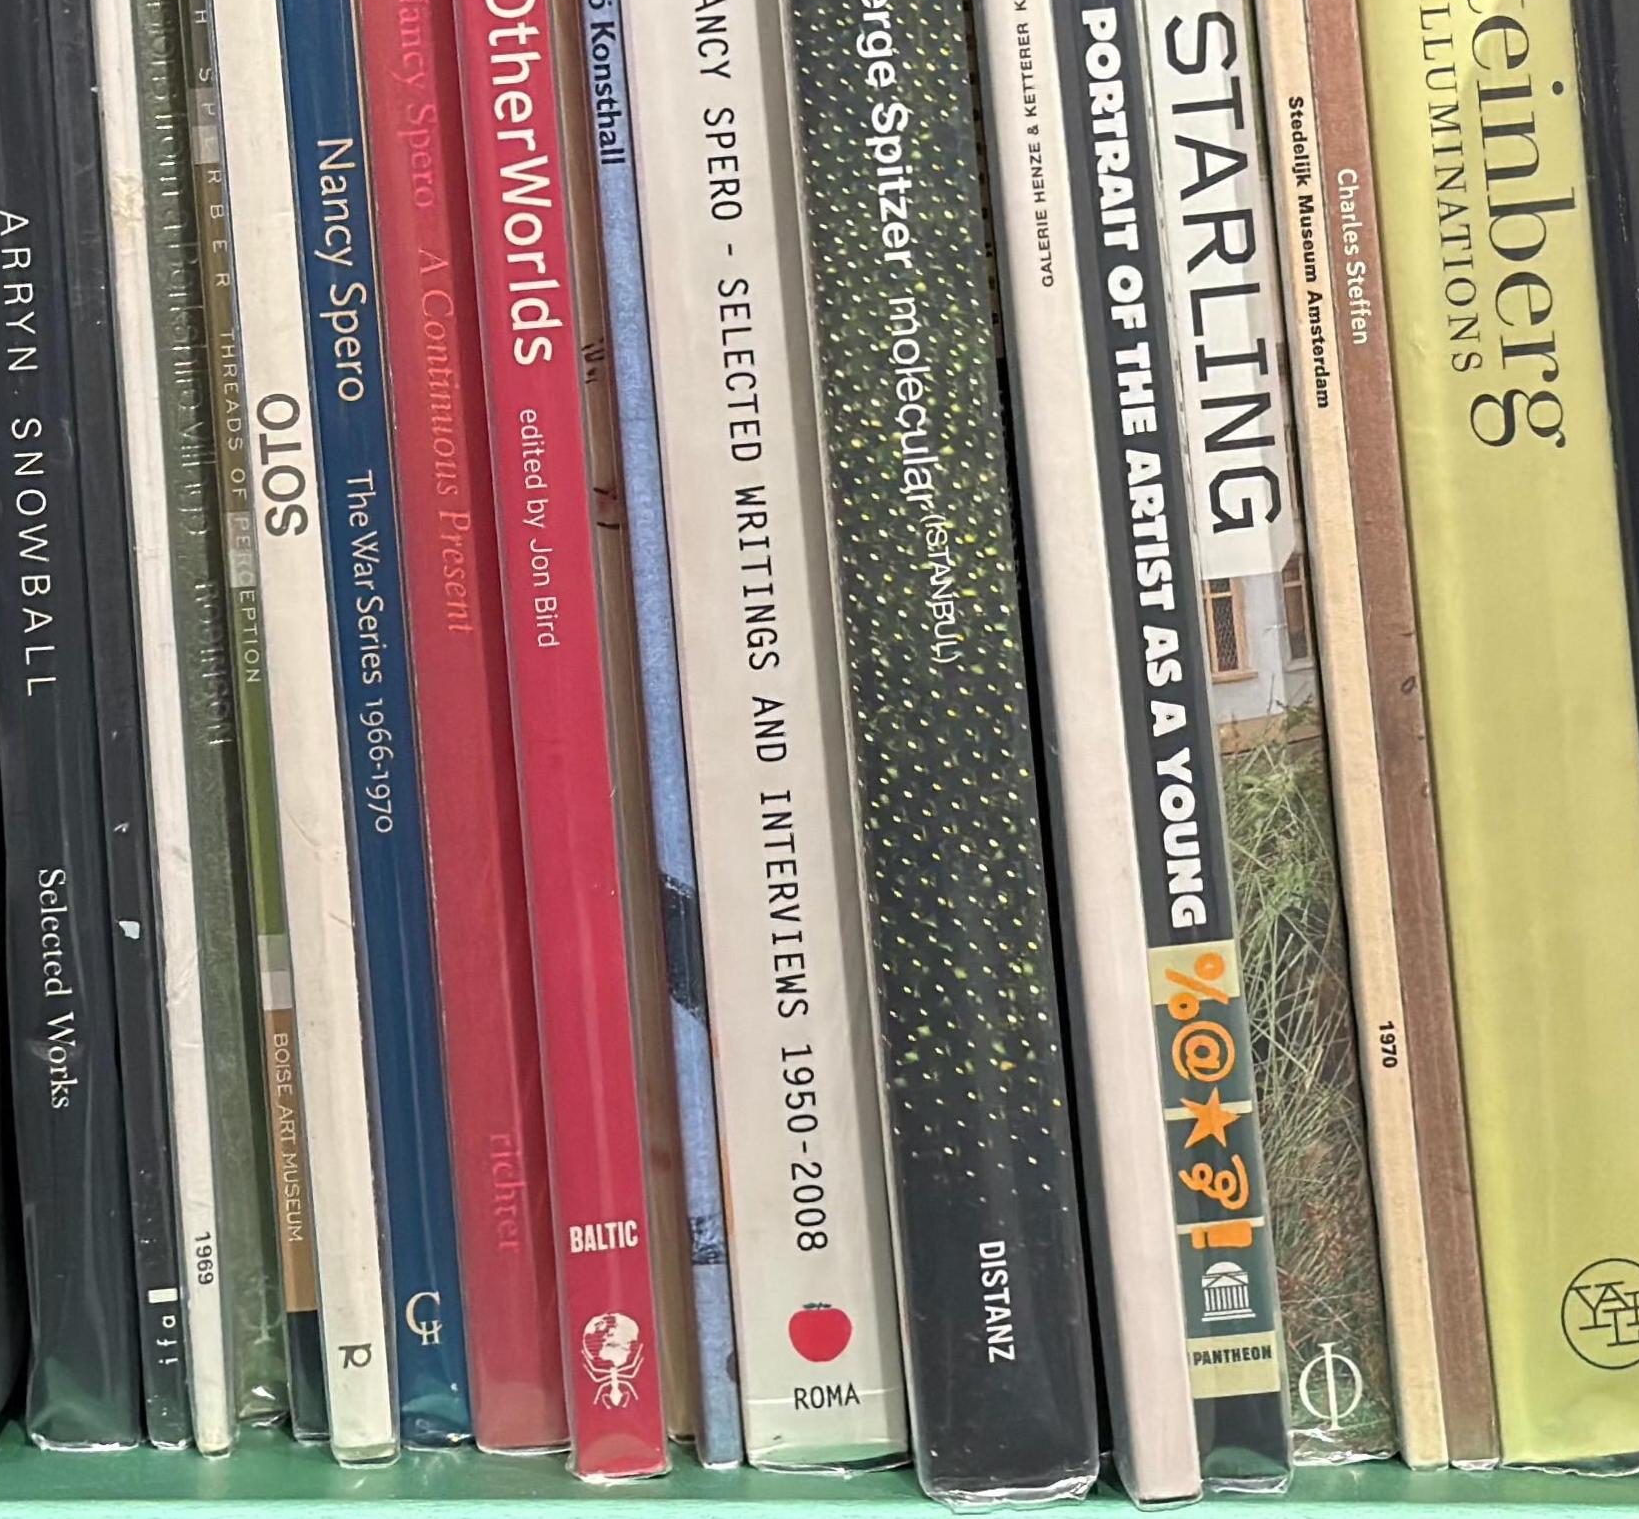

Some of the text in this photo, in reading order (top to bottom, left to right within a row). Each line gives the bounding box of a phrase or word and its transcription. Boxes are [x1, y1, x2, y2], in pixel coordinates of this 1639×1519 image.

[401, 104, 436, 207] Spero
[589, 21, 625, 166] Konsthall
[704, 108, 742, 220] SPERO
[869, 101, 914, 269] Spitzer
[1338, 169, 1371, 344] Charles Steffen
[315, 138, 365, 401] Nancy Spero
[1165, 11, 1281, 534] STARLING
[0, 211, 56, 696] ARRYN SNOWBALL
[718, 279, 761, 461] SELECTED
[887, 296, 935, 509] molecular
[221, 329, 261, 685] THREADS OF PERCEPTION
[257, 394, 308, 536] SOTO
[1082, 8, 1208, 929] PORTRAIT OF THE ARTIST AS A YOUNG
[735, 486, 779, 670] WRITINGS
[919, 512, 961, 664] (ISTANBUL)
[752, 697, 786, 762] AND
[761, 790, 808, 1018] INTERVIEWS
[39, 869, 78, 1108] Selected Works
[1379, 1021, 1397, 1068] 1970
[782, 1045, 828, 1251] 1950-2008
[195, 1232, 213, 1284] 1969
[568, 1220, 641, 1253] BALTIC
[979, 1241, 1015, 1362] DISTANZ
[793, 1386, 862, 1411] ROMA
[1193, 1347, 1273, 1365] PANTHEON
